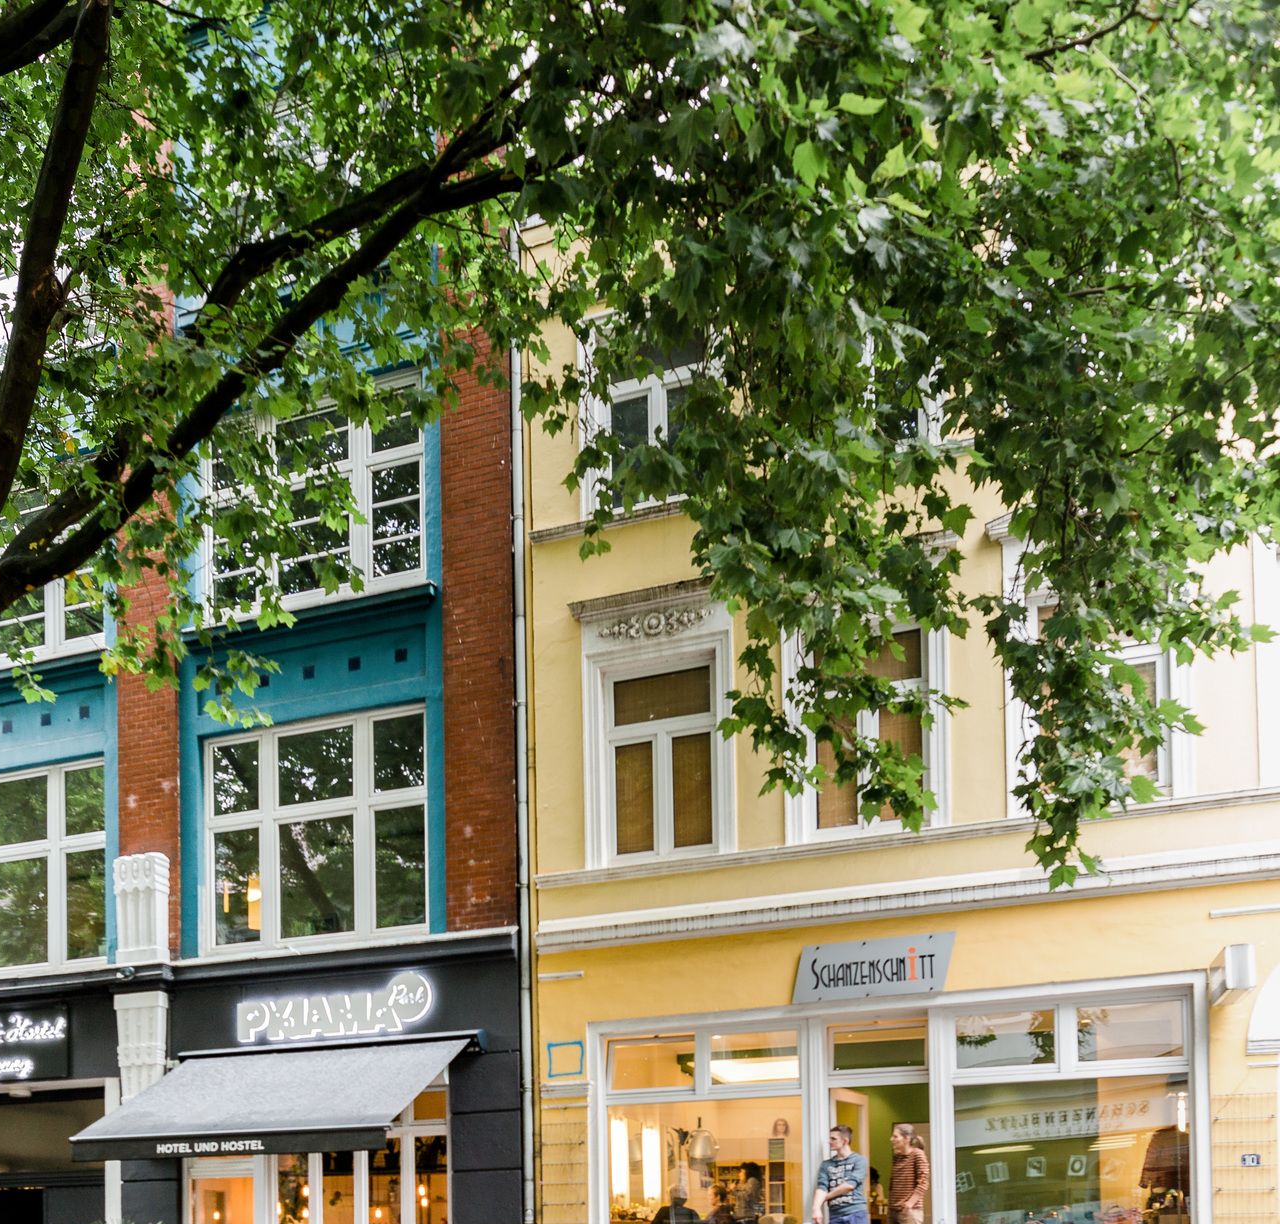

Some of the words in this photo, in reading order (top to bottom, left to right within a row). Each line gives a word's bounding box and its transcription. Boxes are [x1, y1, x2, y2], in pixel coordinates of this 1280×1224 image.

[156, 1143, 192, 1153] HOTEL
[194, 1142, 219, 1152] UND
[221, 1140, 265, 1151] HOSTEL
